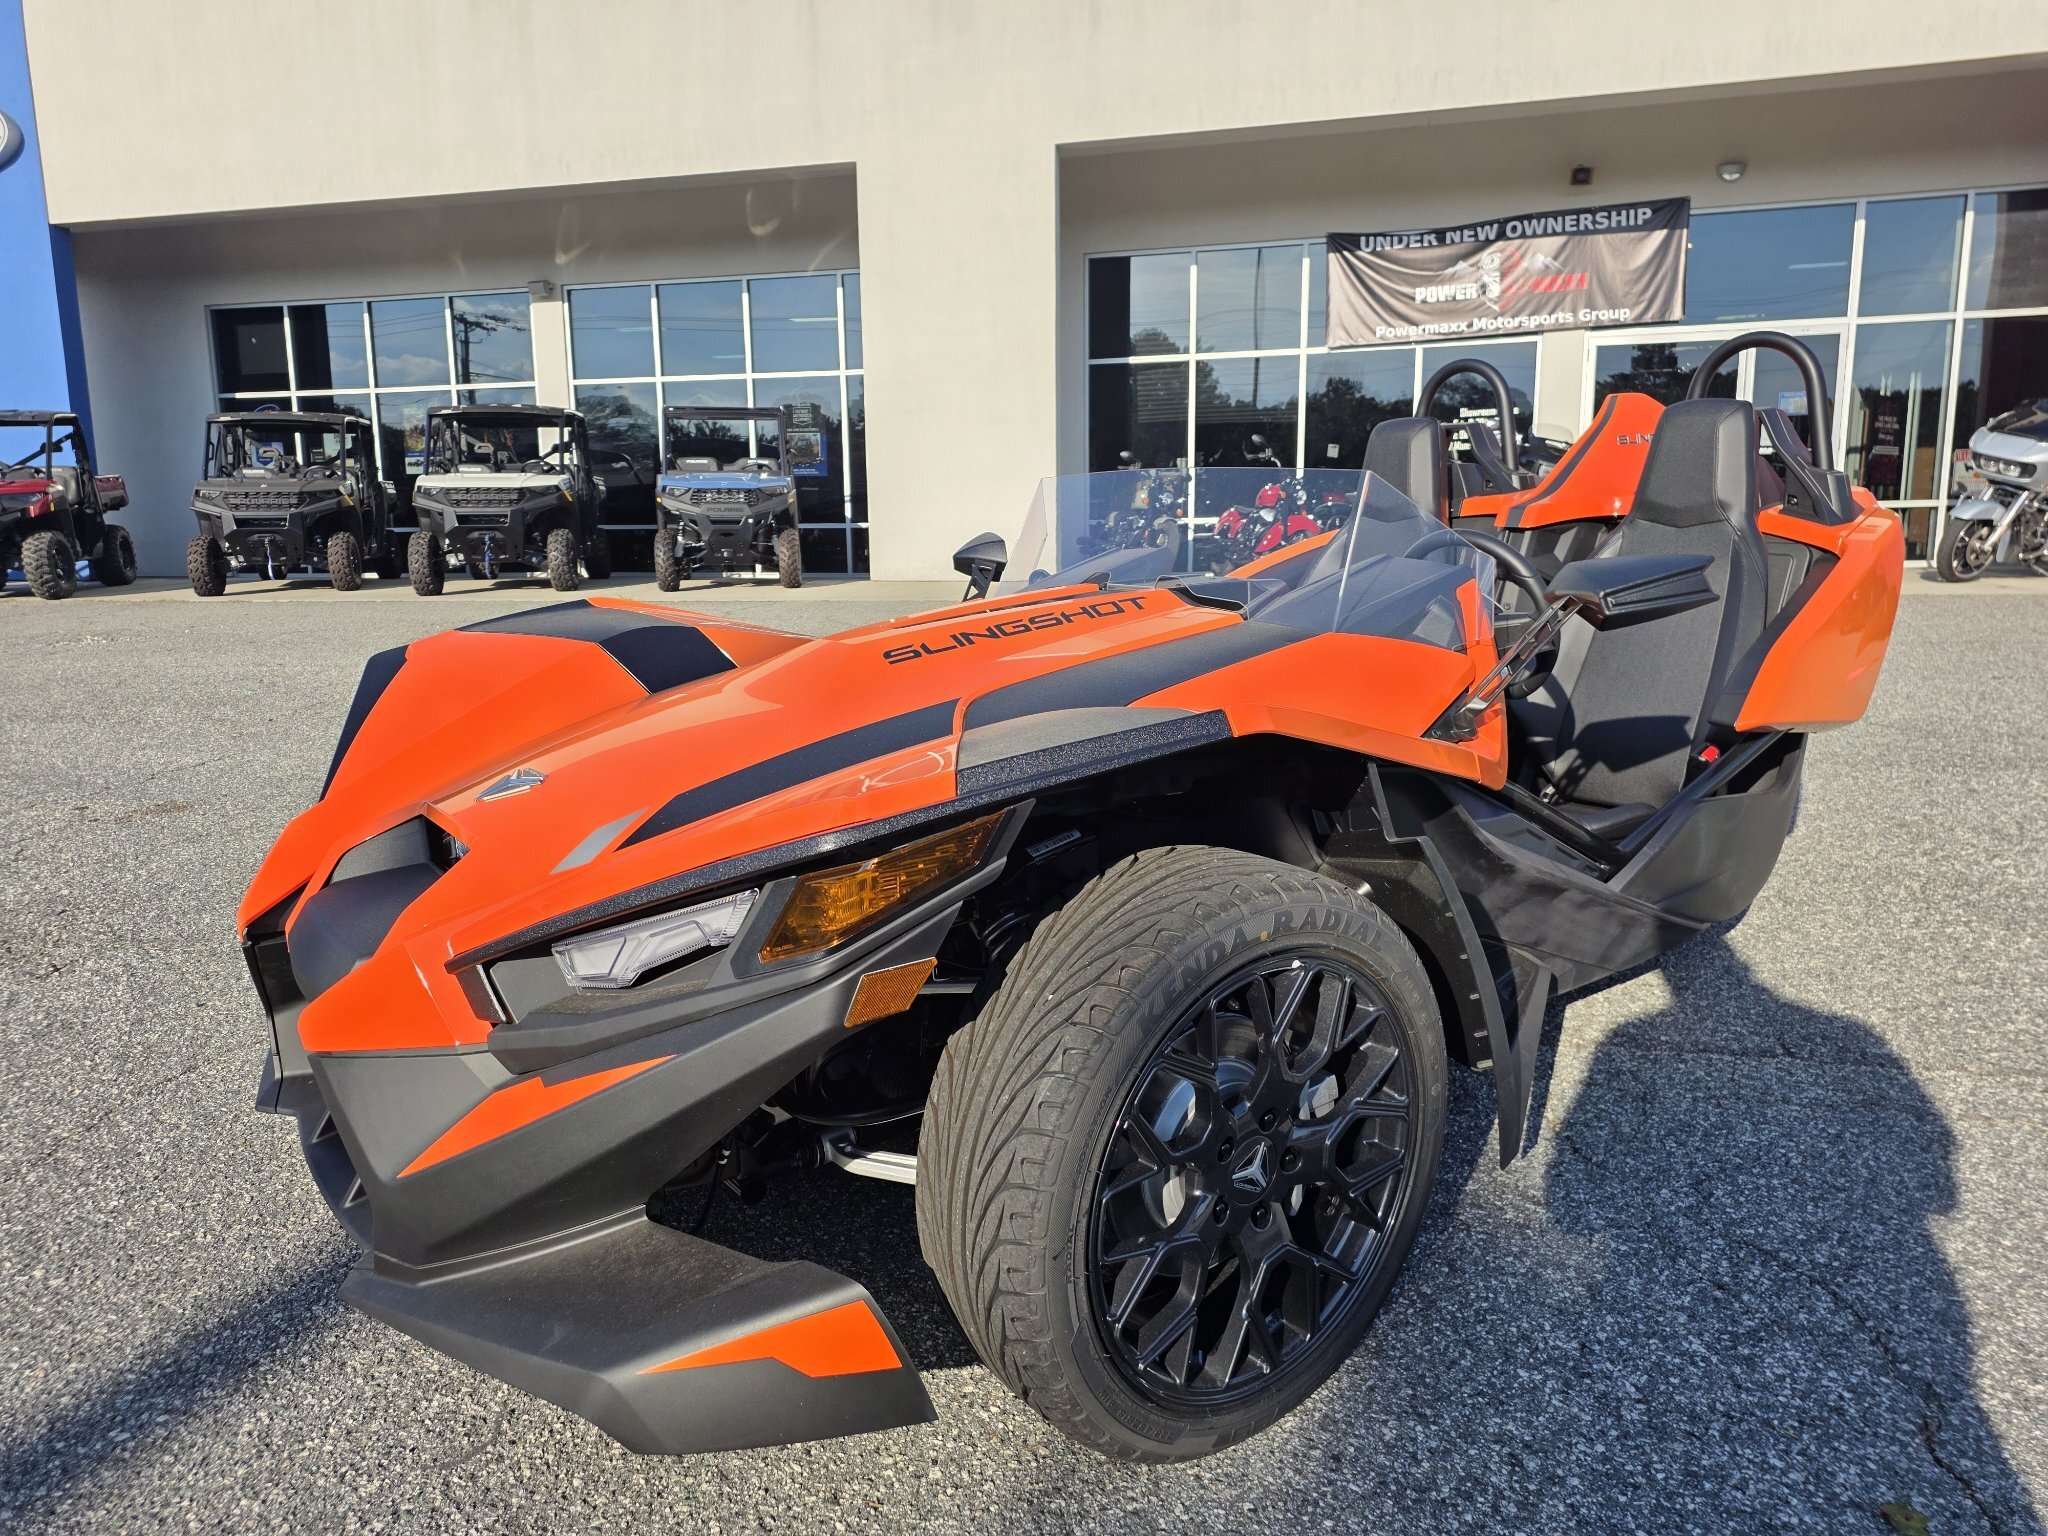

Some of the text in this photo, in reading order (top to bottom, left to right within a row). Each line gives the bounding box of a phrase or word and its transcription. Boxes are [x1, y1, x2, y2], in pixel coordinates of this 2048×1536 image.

[1360, 207, 1652, 252] UNDER NEW OWNERSHIP
[1415, 283, 1478, 304] POWER
[1375, 308, 1631, 338] Powermaxx Motorsports Group
[1616, 433, 1655, 446] SLIN
[882, 596, 1147, 665] SLINGSHOT
[1270, 905, 1382, 953] RADIAL
